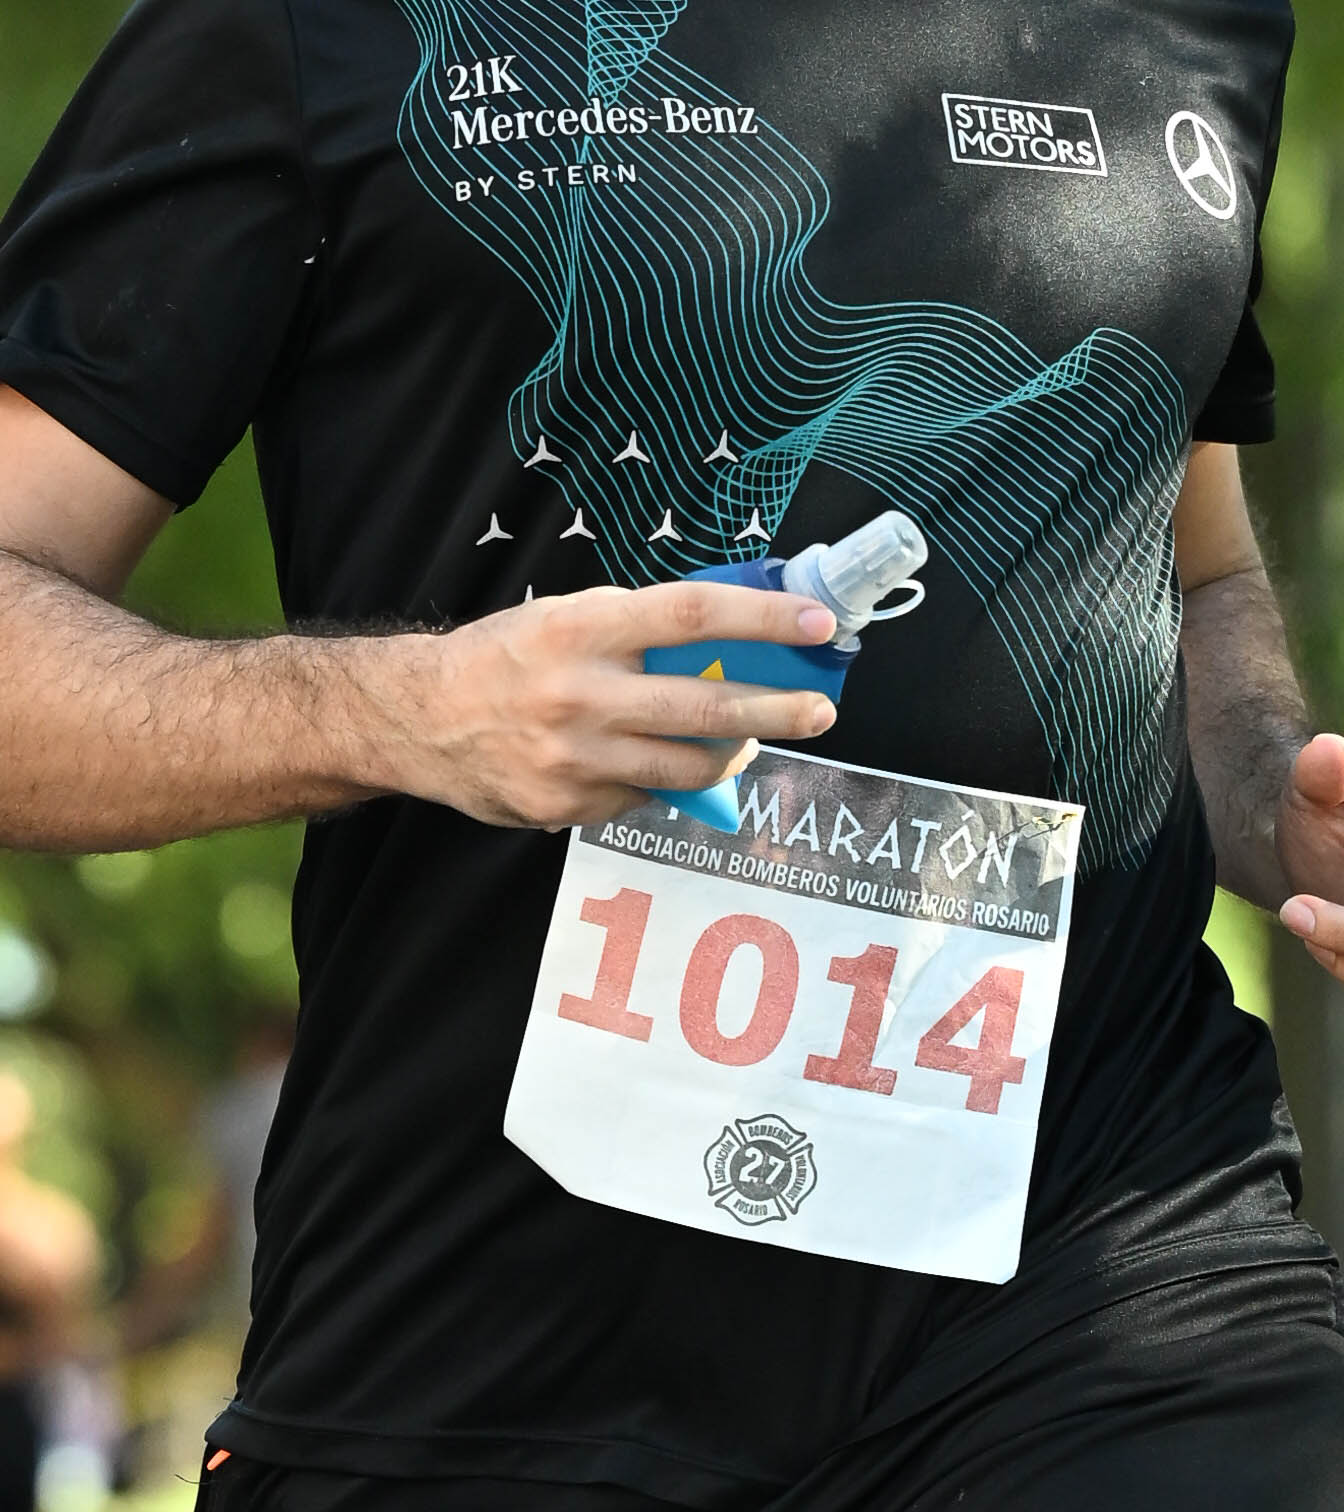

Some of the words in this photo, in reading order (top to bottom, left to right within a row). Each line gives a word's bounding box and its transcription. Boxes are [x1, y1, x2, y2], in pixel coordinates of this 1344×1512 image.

[446, 55, 523, 102] 21K
[450, 97, 759, 150] Mercedes-Benz
[954, 104, 1054, 138] STERN
[956, 129, 1098, 167] MOTORS
[455, 175, 495, 202] BY
[517, 164, 637, 191] STERN
[735, 781, 1018, 888] MARATÓN
[600, 822, 723, 870] ASOCIACIÓN
[727, 852, 840, 897] BOMBEROS
[845, 878, 967, 922] VOLUNTARIOS
[972, 903, 1051, 936] ROSARIO
[557, 886, 1027, 1117] 1014
[738, 1146, 786, 1186] 27
